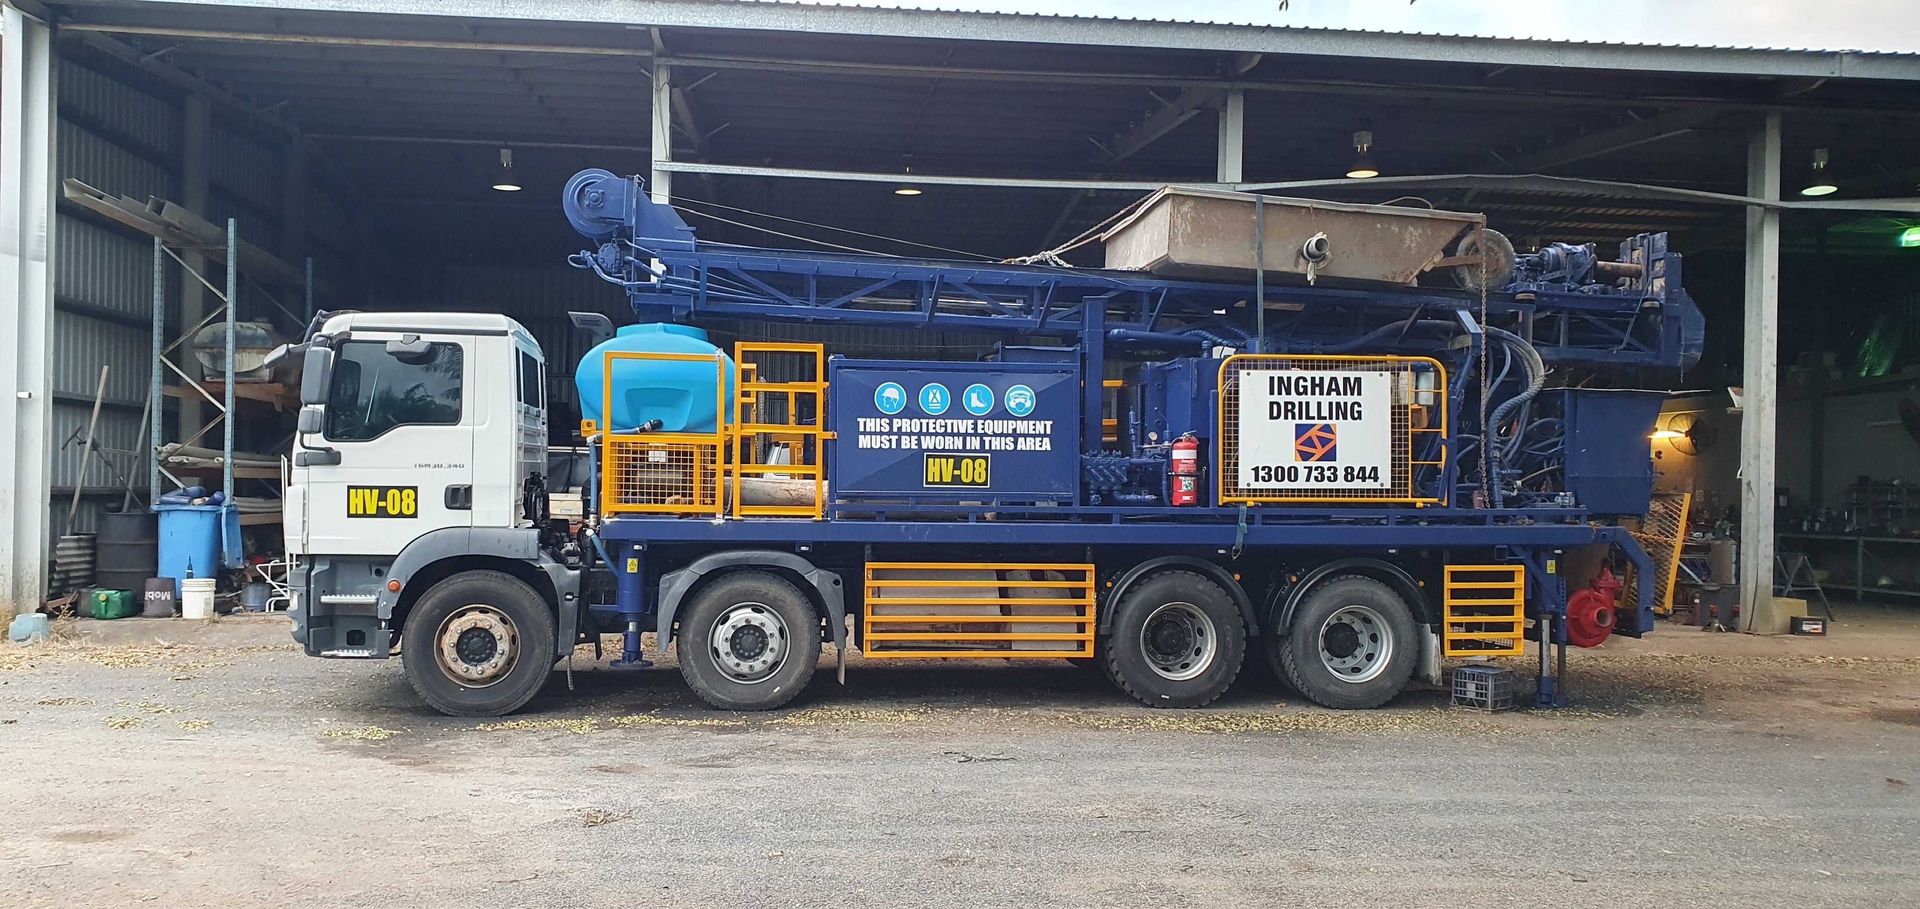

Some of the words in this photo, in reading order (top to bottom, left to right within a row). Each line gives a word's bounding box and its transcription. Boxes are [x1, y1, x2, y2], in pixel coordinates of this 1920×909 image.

[1268, 376, 1362, 396] INGHAM
[1268, 401, 1363, 421] DRILLING
[857, 417, 890, 432] THIS
[892, 418, 975, 434] PROTECTIVE
[977, 420, 1053, 435] EQUIPMENT
[858, 435, 899, 449] MUST
[901, 435, 918, 449] BE
[920, 436, 963, 450] WORN
[965, 436, 981, 450] IN
[983, 436, 1015, 450] THIS
[1016, 437, 1052, 451] AREA
[926, 457, 987, 483] HV-08
[1250, 465, 1299, 483] 1300
[1303, 466, 1339, 483] 733
[1343, 466, 1380, 483] 844
[348, 488, 416, 515] HV-08
